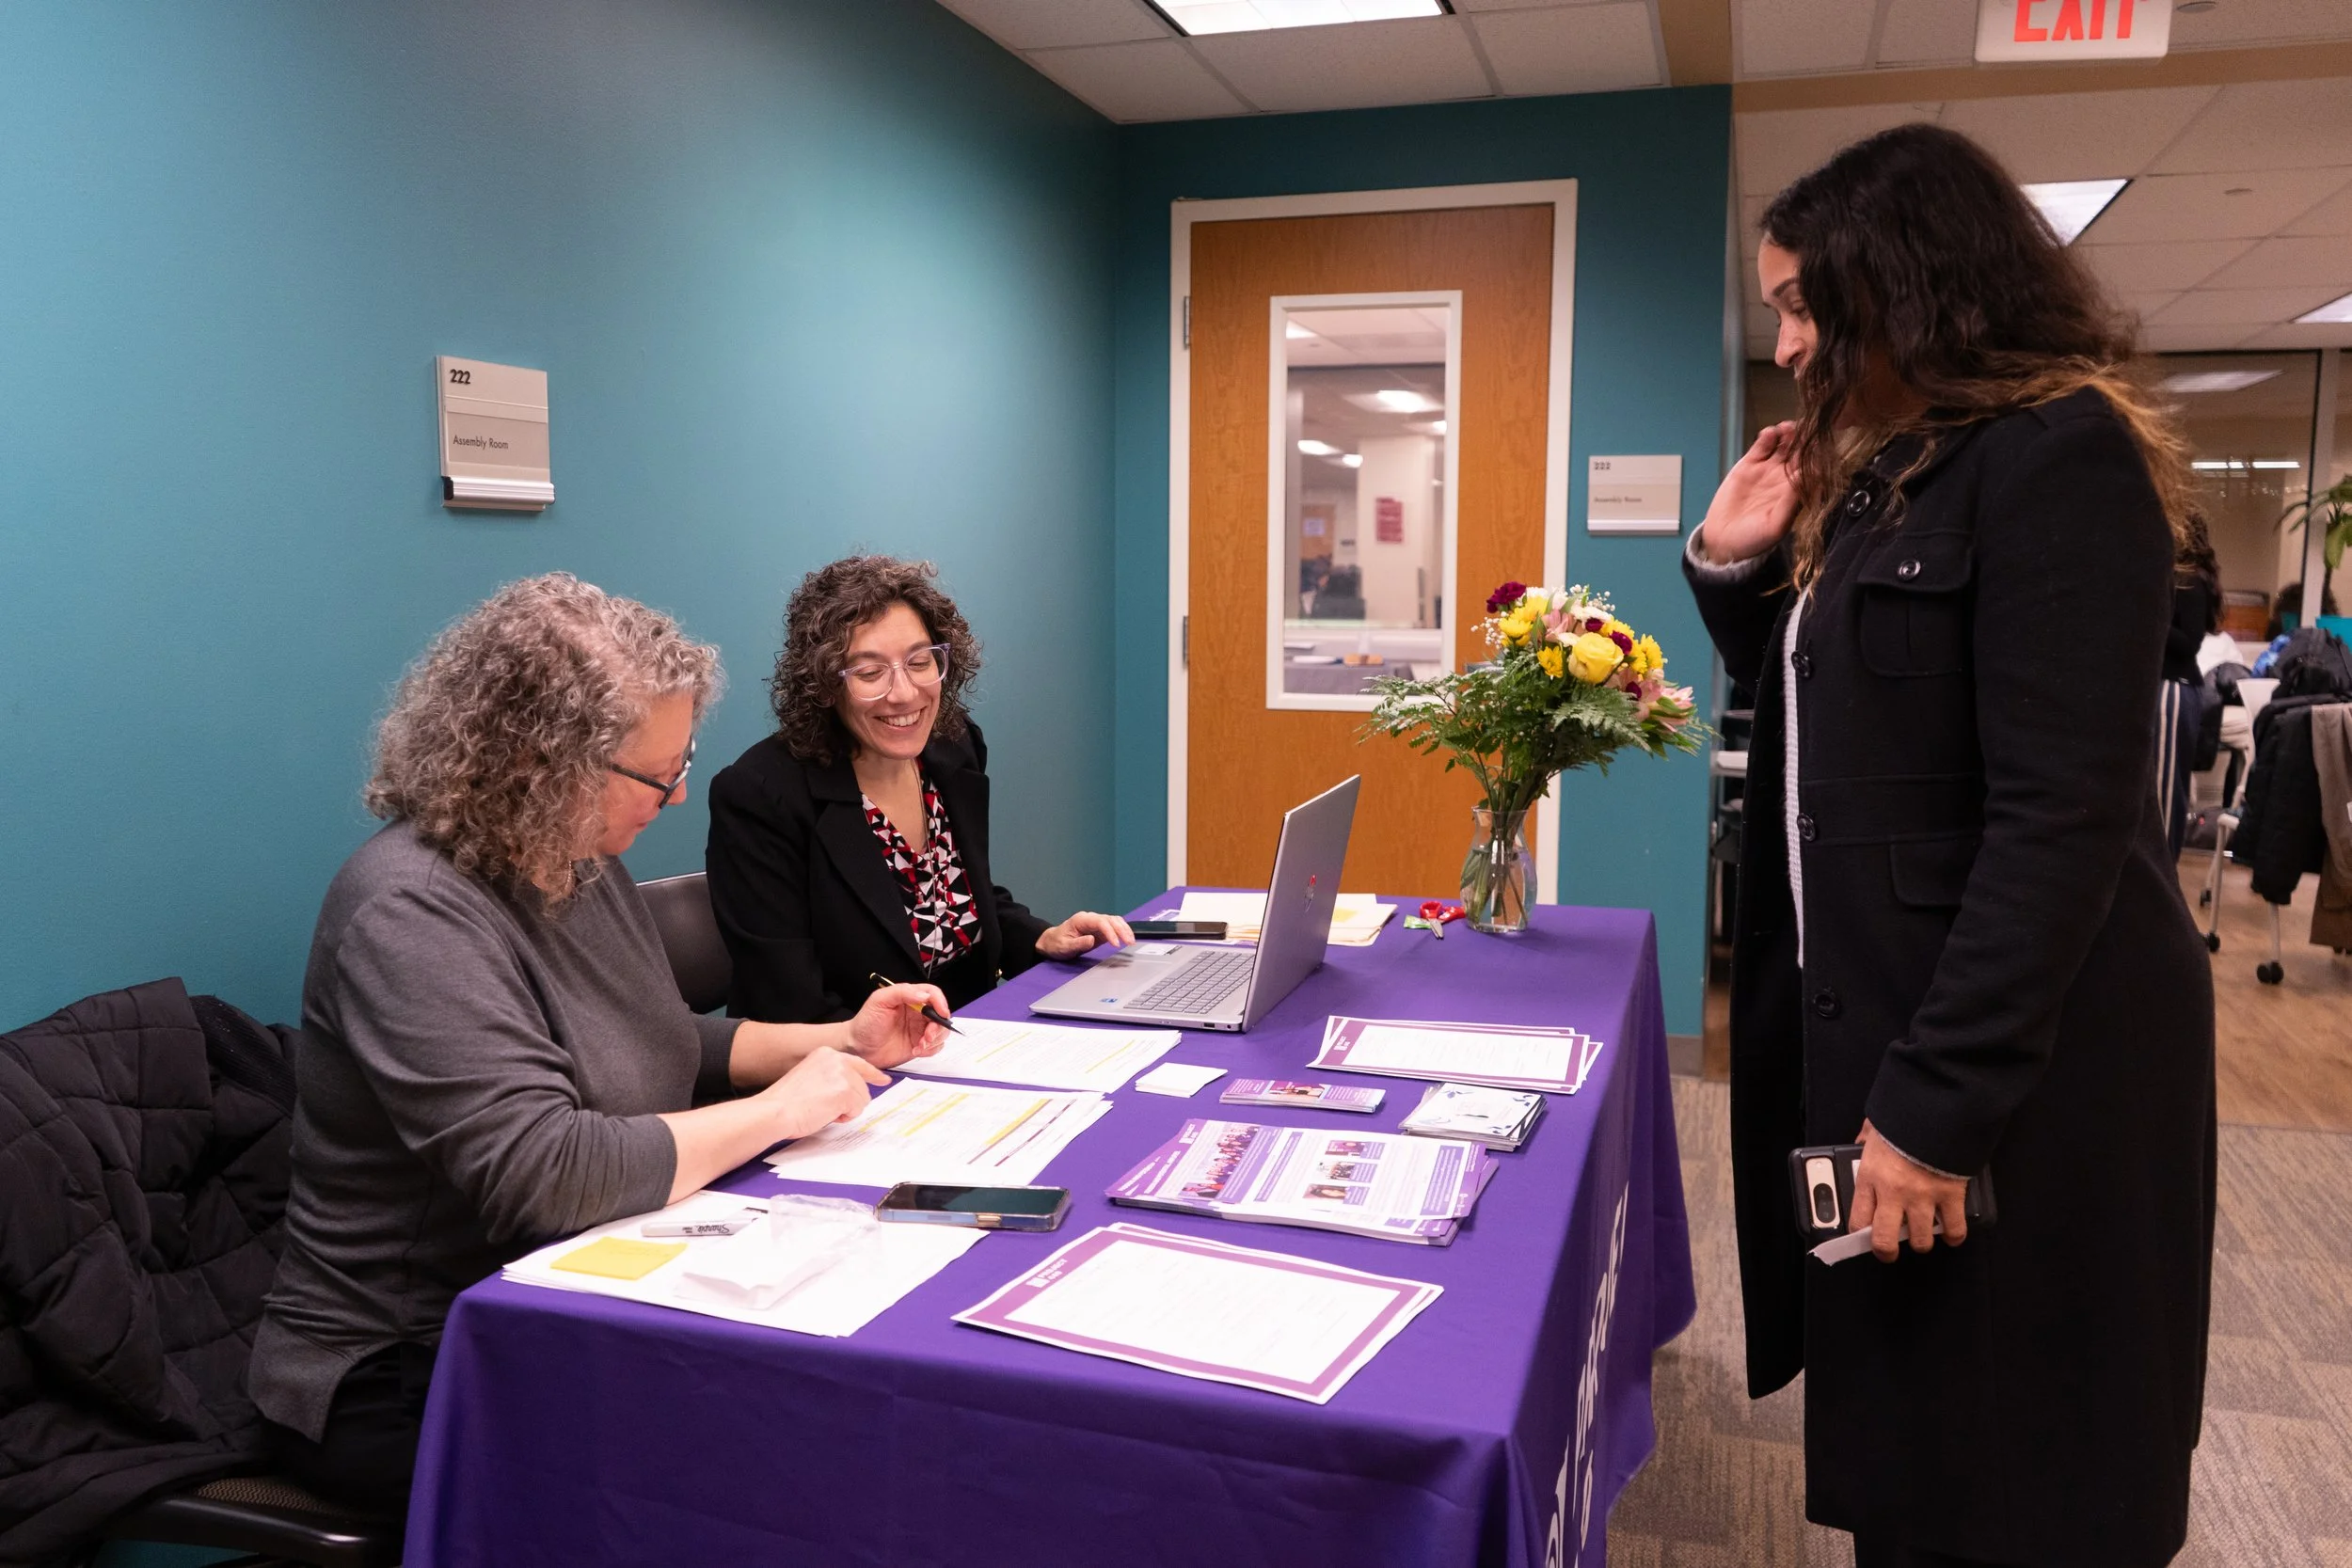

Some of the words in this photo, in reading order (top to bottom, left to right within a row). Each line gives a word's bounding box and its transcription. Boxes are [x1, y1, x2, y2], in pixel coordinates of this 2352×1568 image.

[450, 369, 471, 385] 222
[453, 435, 487, 451] Assembly
[488, 437, 509, 450] Room
[1594, 461, 1612, 471] 222
[694, 1223, 730, 1234] Sharpie
